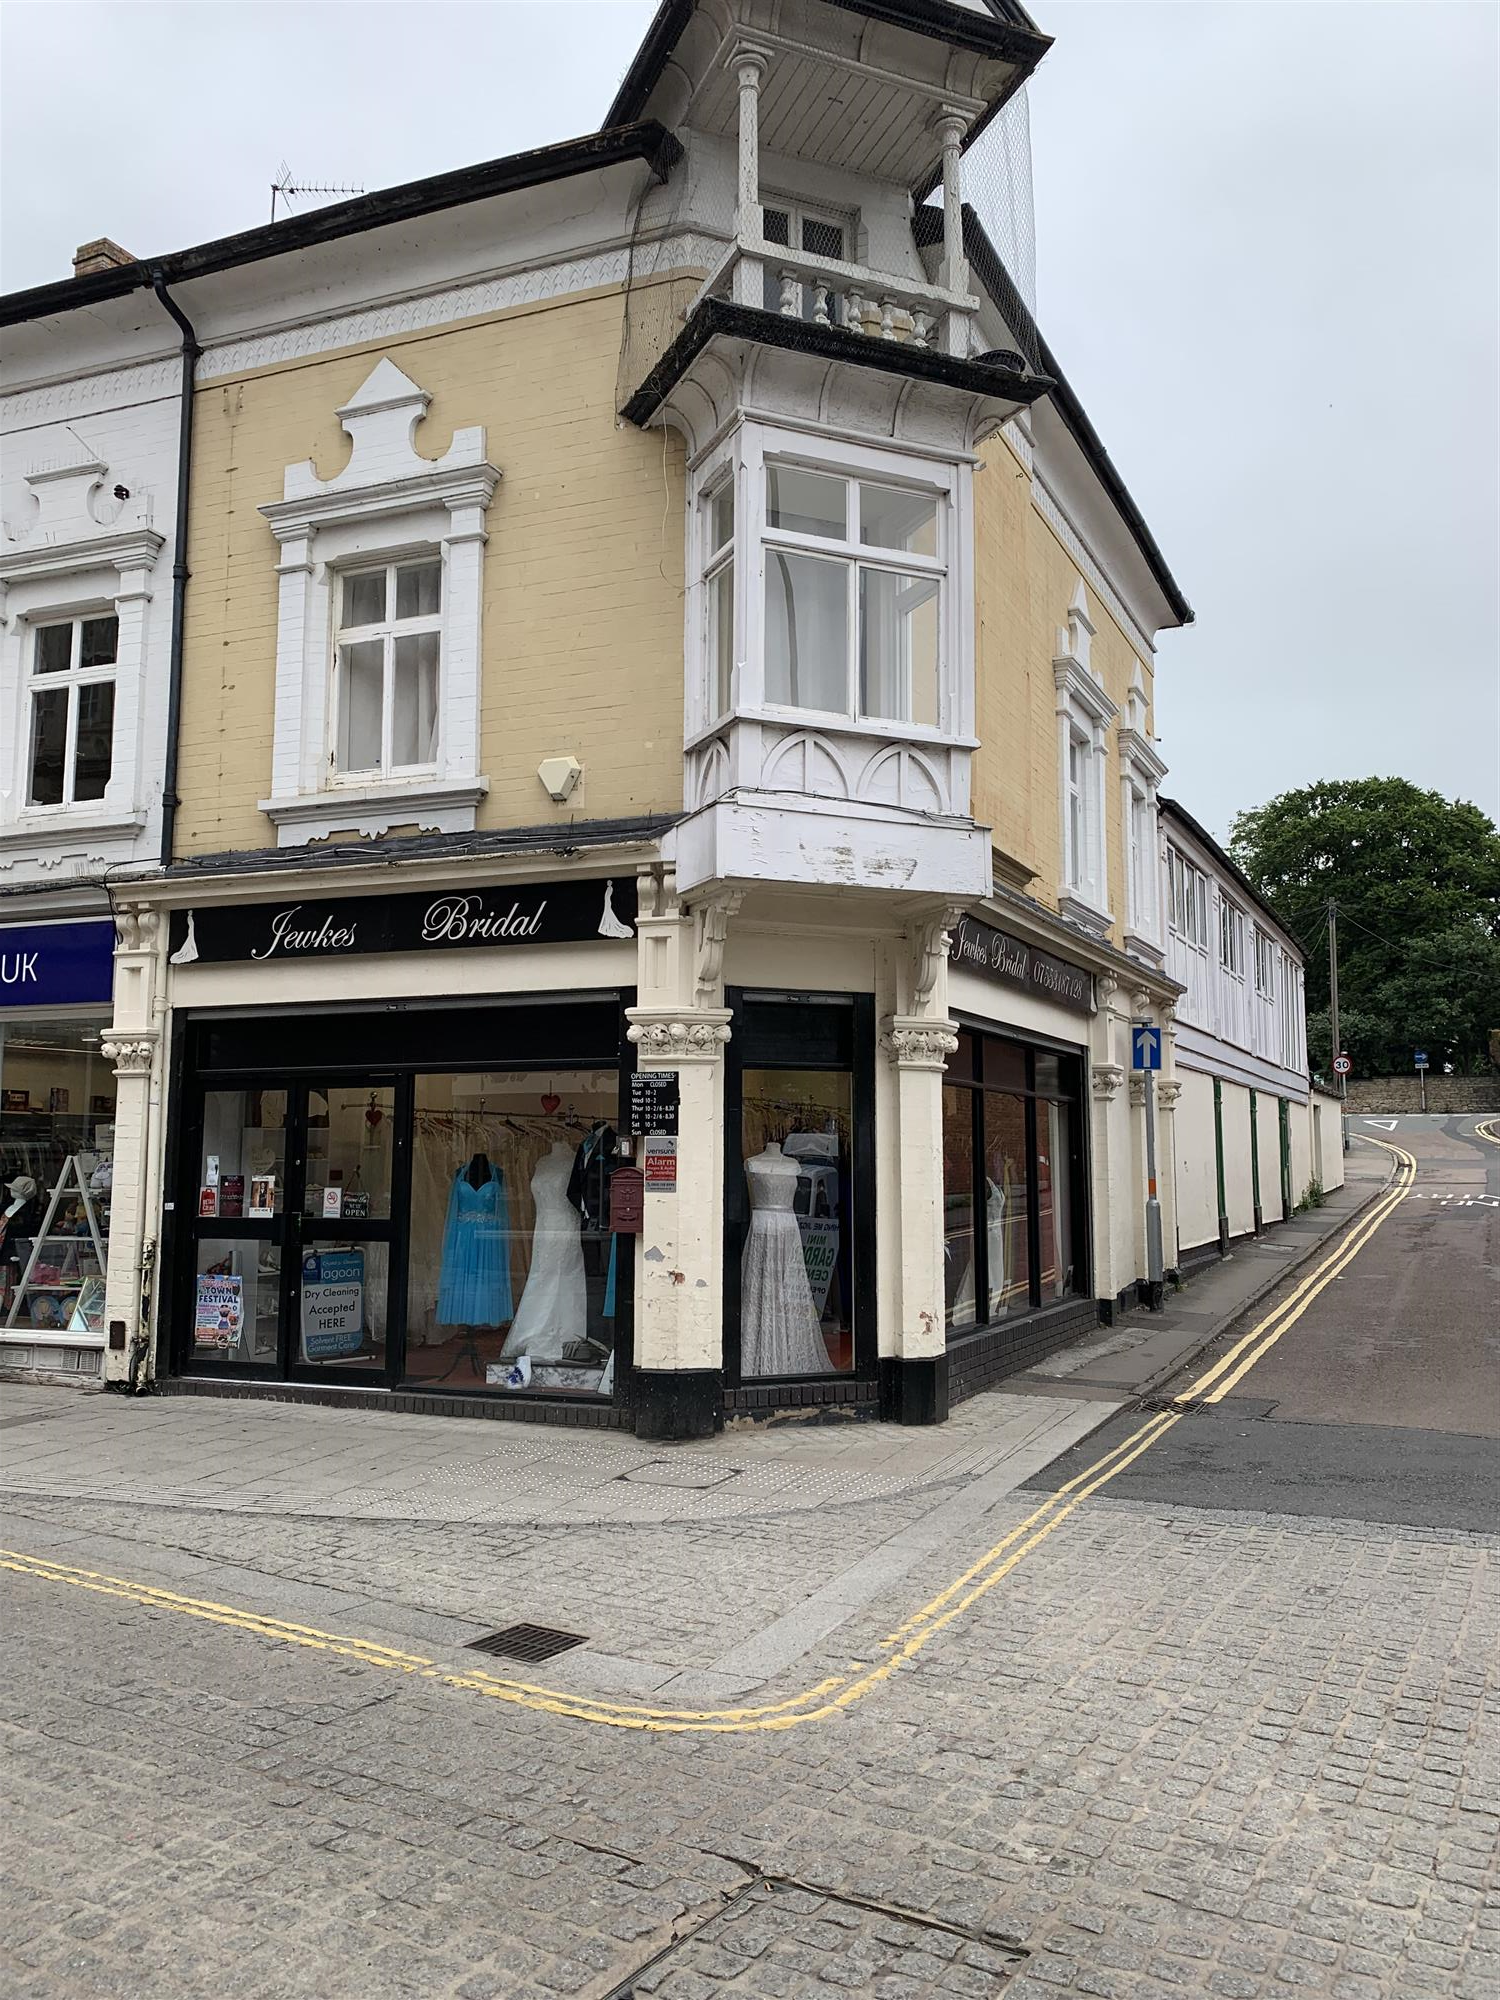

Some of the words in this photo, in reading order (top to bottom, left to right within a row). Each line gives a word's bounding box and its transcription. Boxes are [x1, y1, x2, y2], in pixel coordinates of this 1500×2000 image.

[251, 905, 357, 961] Jewkes
[421, 896, 549, 941] Bridal
[951, 918, 988, 965] Jewkes
[991, 933, 1027, 980] Bridal
[1, 952, 39, 983] UK
[1335, 1061, 1349, 1069] 30
[647, 1157, 675, 1166] Alarm
[345, 1209, 366, 1217] OPEN
[321, 1267, 360, 1280] lagoon
[205, 1286, 232, 1295] TOWN
[304, 1290, 320, 1300] Dry
[322, 1287, 359, 1298] Cleaning
[198, 1295, 239, 1304] FESTIVAL
[309, 1301, 356, 1315] Accepted
[318, 1317, 346, 1329] HERE
